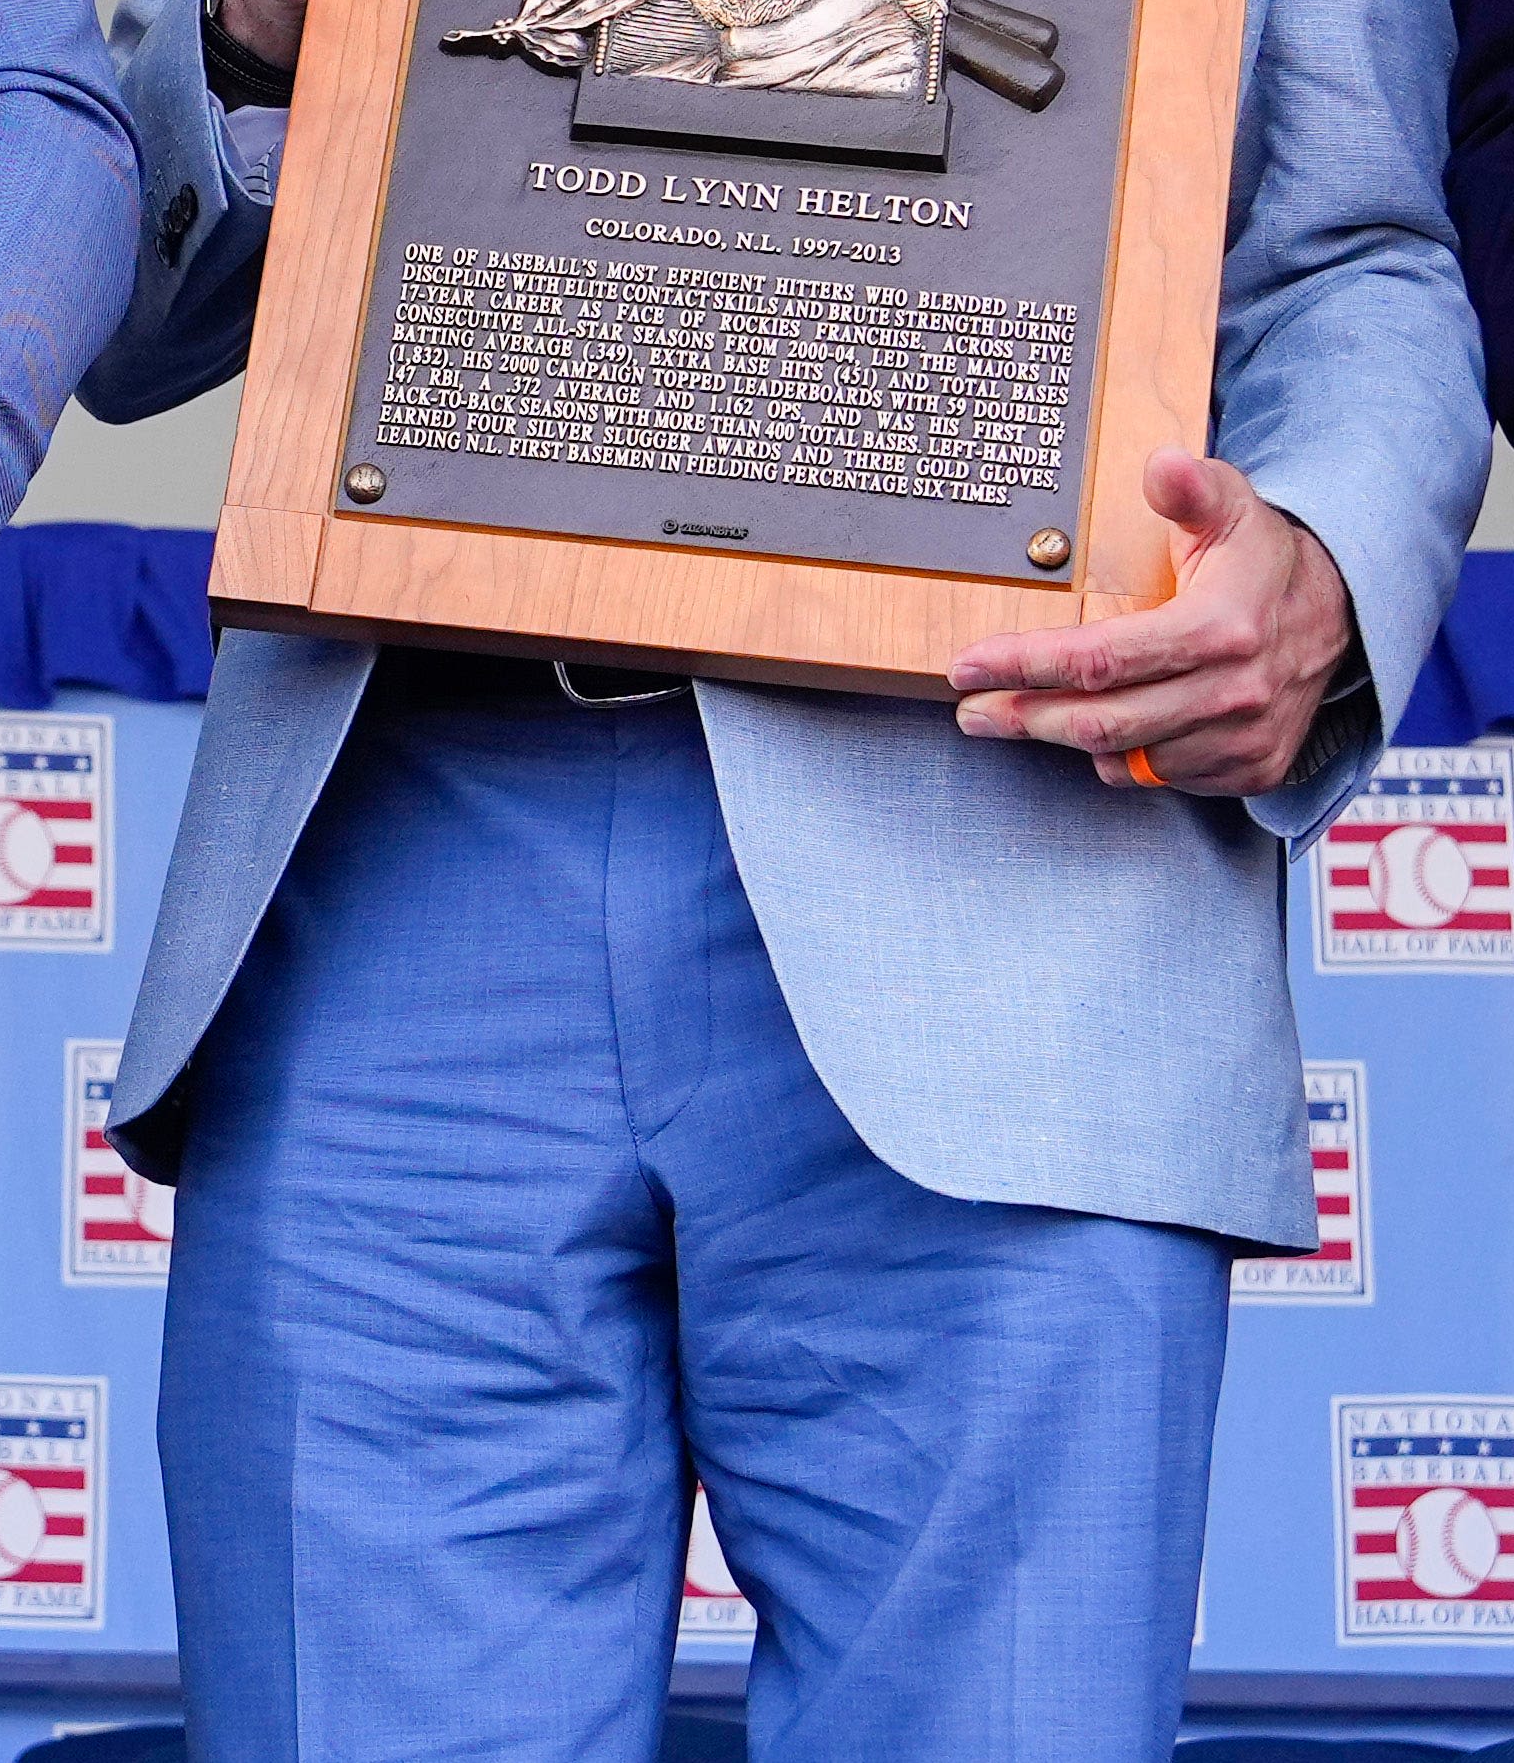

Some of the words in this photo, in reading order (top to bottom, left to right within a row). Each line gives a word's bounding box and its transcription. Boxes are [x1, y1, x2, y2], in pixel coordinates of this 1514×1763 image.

[529, 162, 646, 197] TODD
[660, 174, 783, 210] LYNN
[796, 187, 973, 228] HELTON
[585, 217, 727, 250] COLORADO,
[734, 231, 781, 252] N.L.
[792, 236, 900, 264] 1997-2013
[405, 242, 443, 263] ONE
[452, 247, 478, 266] OF
[605, 260, 658, 282] MOST
[665, 266, 766, 293] EFFICIENT
[774, 276, 855, 302] HITTERS
[865, 285, 908, 307] WHO
[916, 290, 1007, 316] BLENDED
[1015, 300, 1077, 322] PLATE
[375, 424, 461, 450] LEADING
[465, 433, 502, 454] N.L.
[507, 437, 563, 460] FIRST
[566, 442, 655, 469] BASEMEN
[658, 451, 681, 471] IN
[685, 453, 778, 481] FIELDING
[782, 464, 909, 494] PERCENTAGE
[912, 476, 945, 498] SIX
[949, 480, 1012, 504] TIMES.
[1397, 753, 1504, 773] IONAL
[1345, 799, 1506, 818] ASEBALL
[1331, 934, 1398, 955] HALL
[1406, 936, 1437, 954] OF
[1448, 936, 1513, 955] FAME
[1242, 1264, 1276, 1285] OF
[1285, 1264, 1353, 1285] FAME
[14, 1587, 84, 1607] FAME
[1354, 1604, 1425, 1626] HALL
[1432, 1604, 1466, 1626] OF
